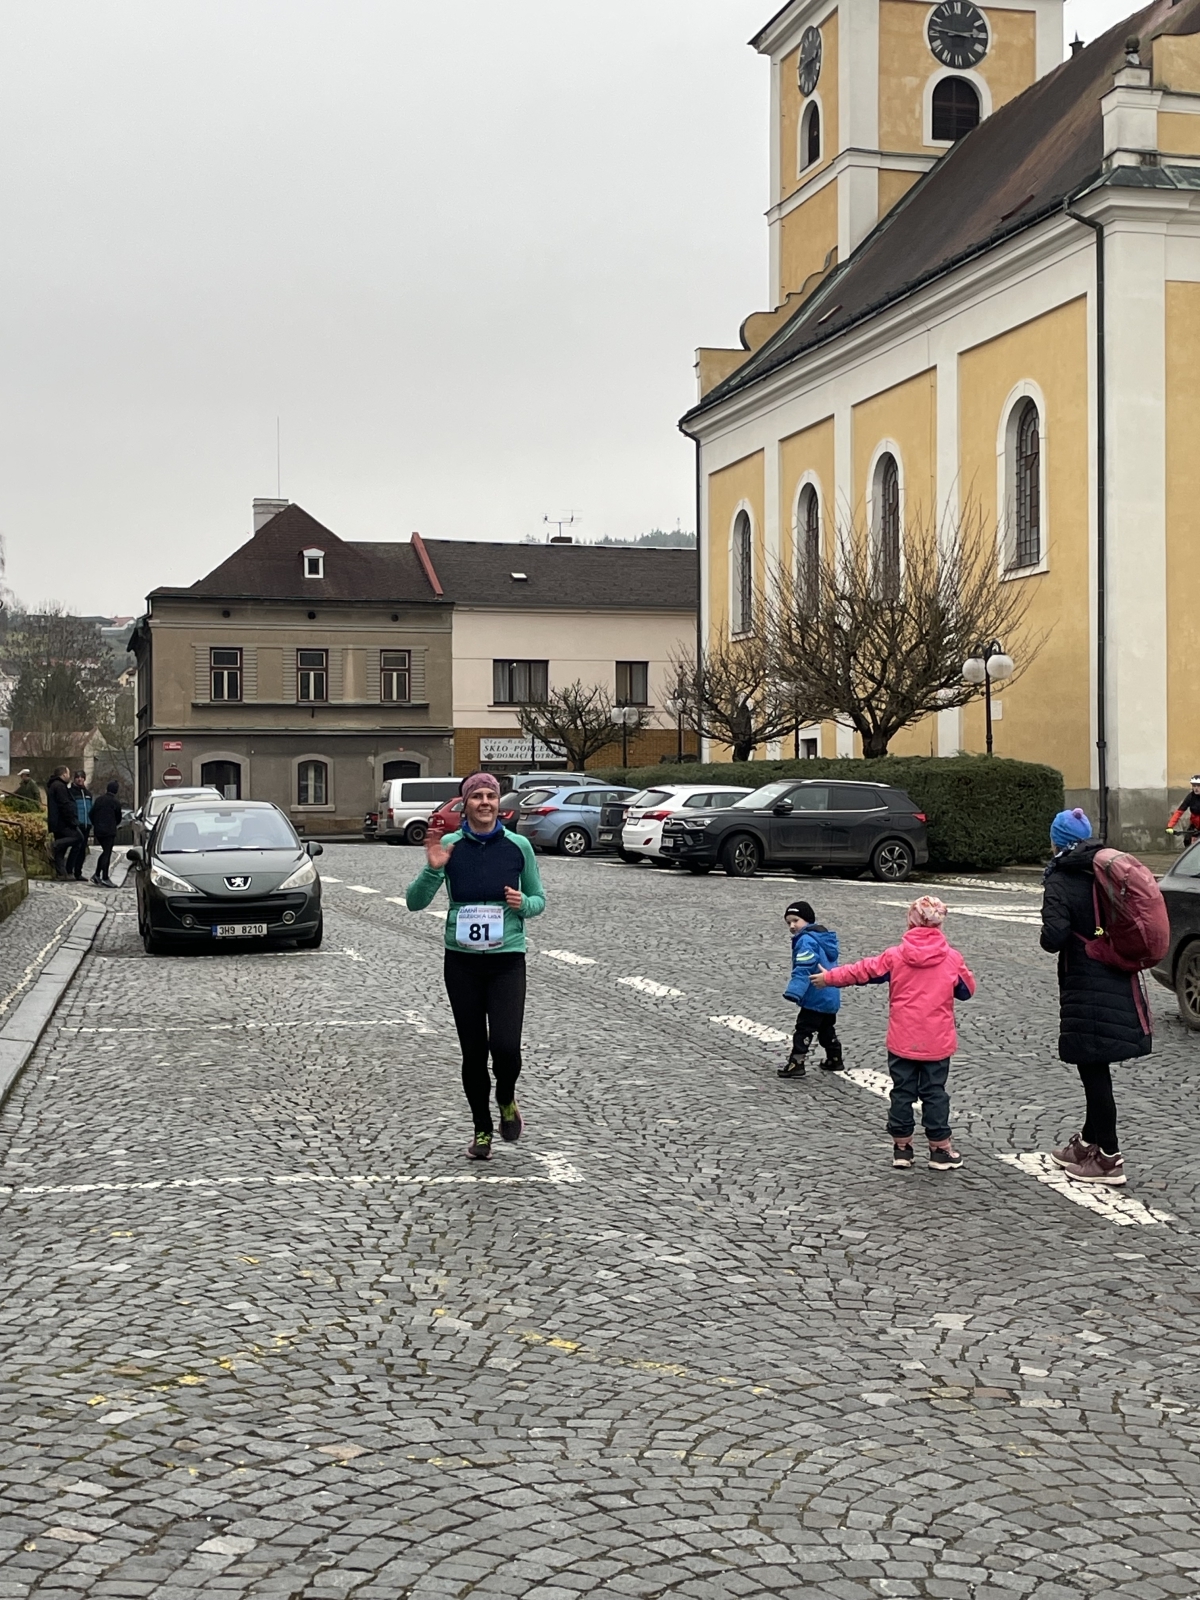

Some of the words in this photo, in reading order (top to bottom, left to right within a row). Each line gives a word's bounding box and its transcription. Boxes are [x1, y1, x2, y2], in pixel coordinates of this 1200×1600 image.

[219, 926, 236, 935] 3H9
[241, 925, 263, 934] 8210
[468, 923, 490, 941] 81
